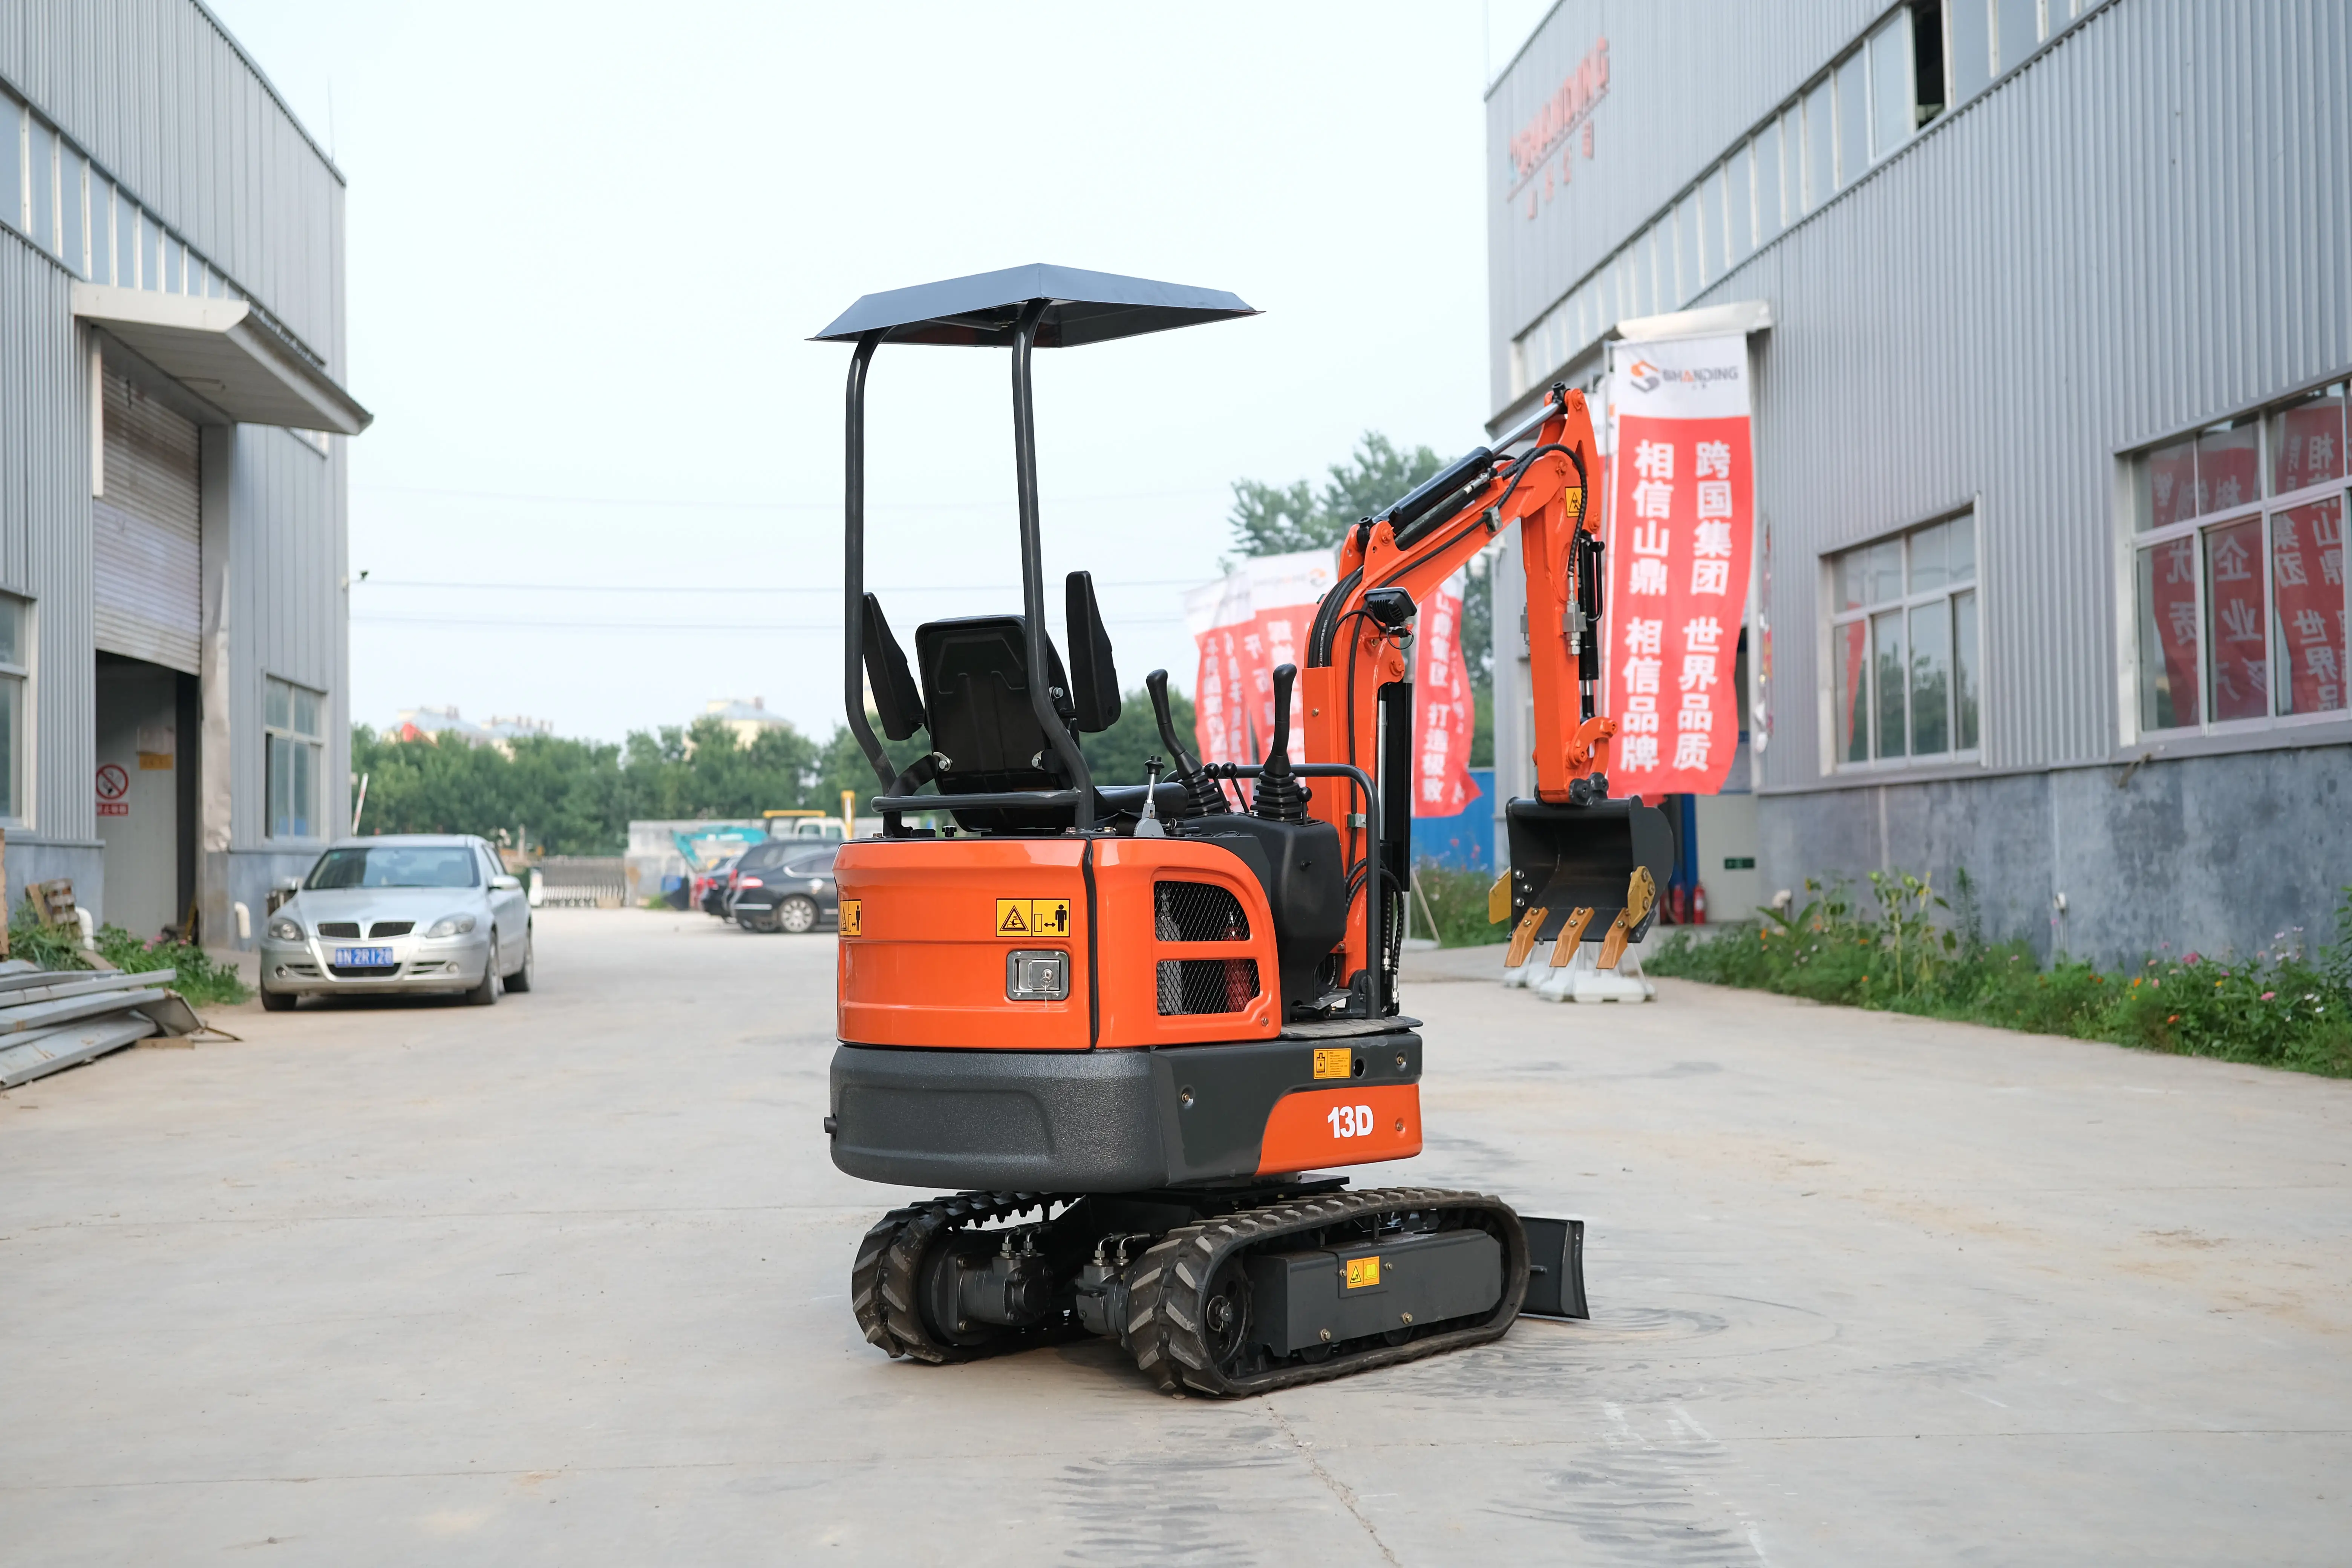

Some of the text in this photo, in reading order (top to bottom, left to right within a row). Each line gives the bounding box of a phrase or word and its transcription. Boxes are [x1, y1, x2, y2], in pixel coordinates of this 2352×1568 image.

[1620, 439, 1674, 772] 相信山鼎 相信品牌
[1672, 440, 1733, 772] 跨国集团 世界品质
[1328, 1105, 1374, 1138] 13D
